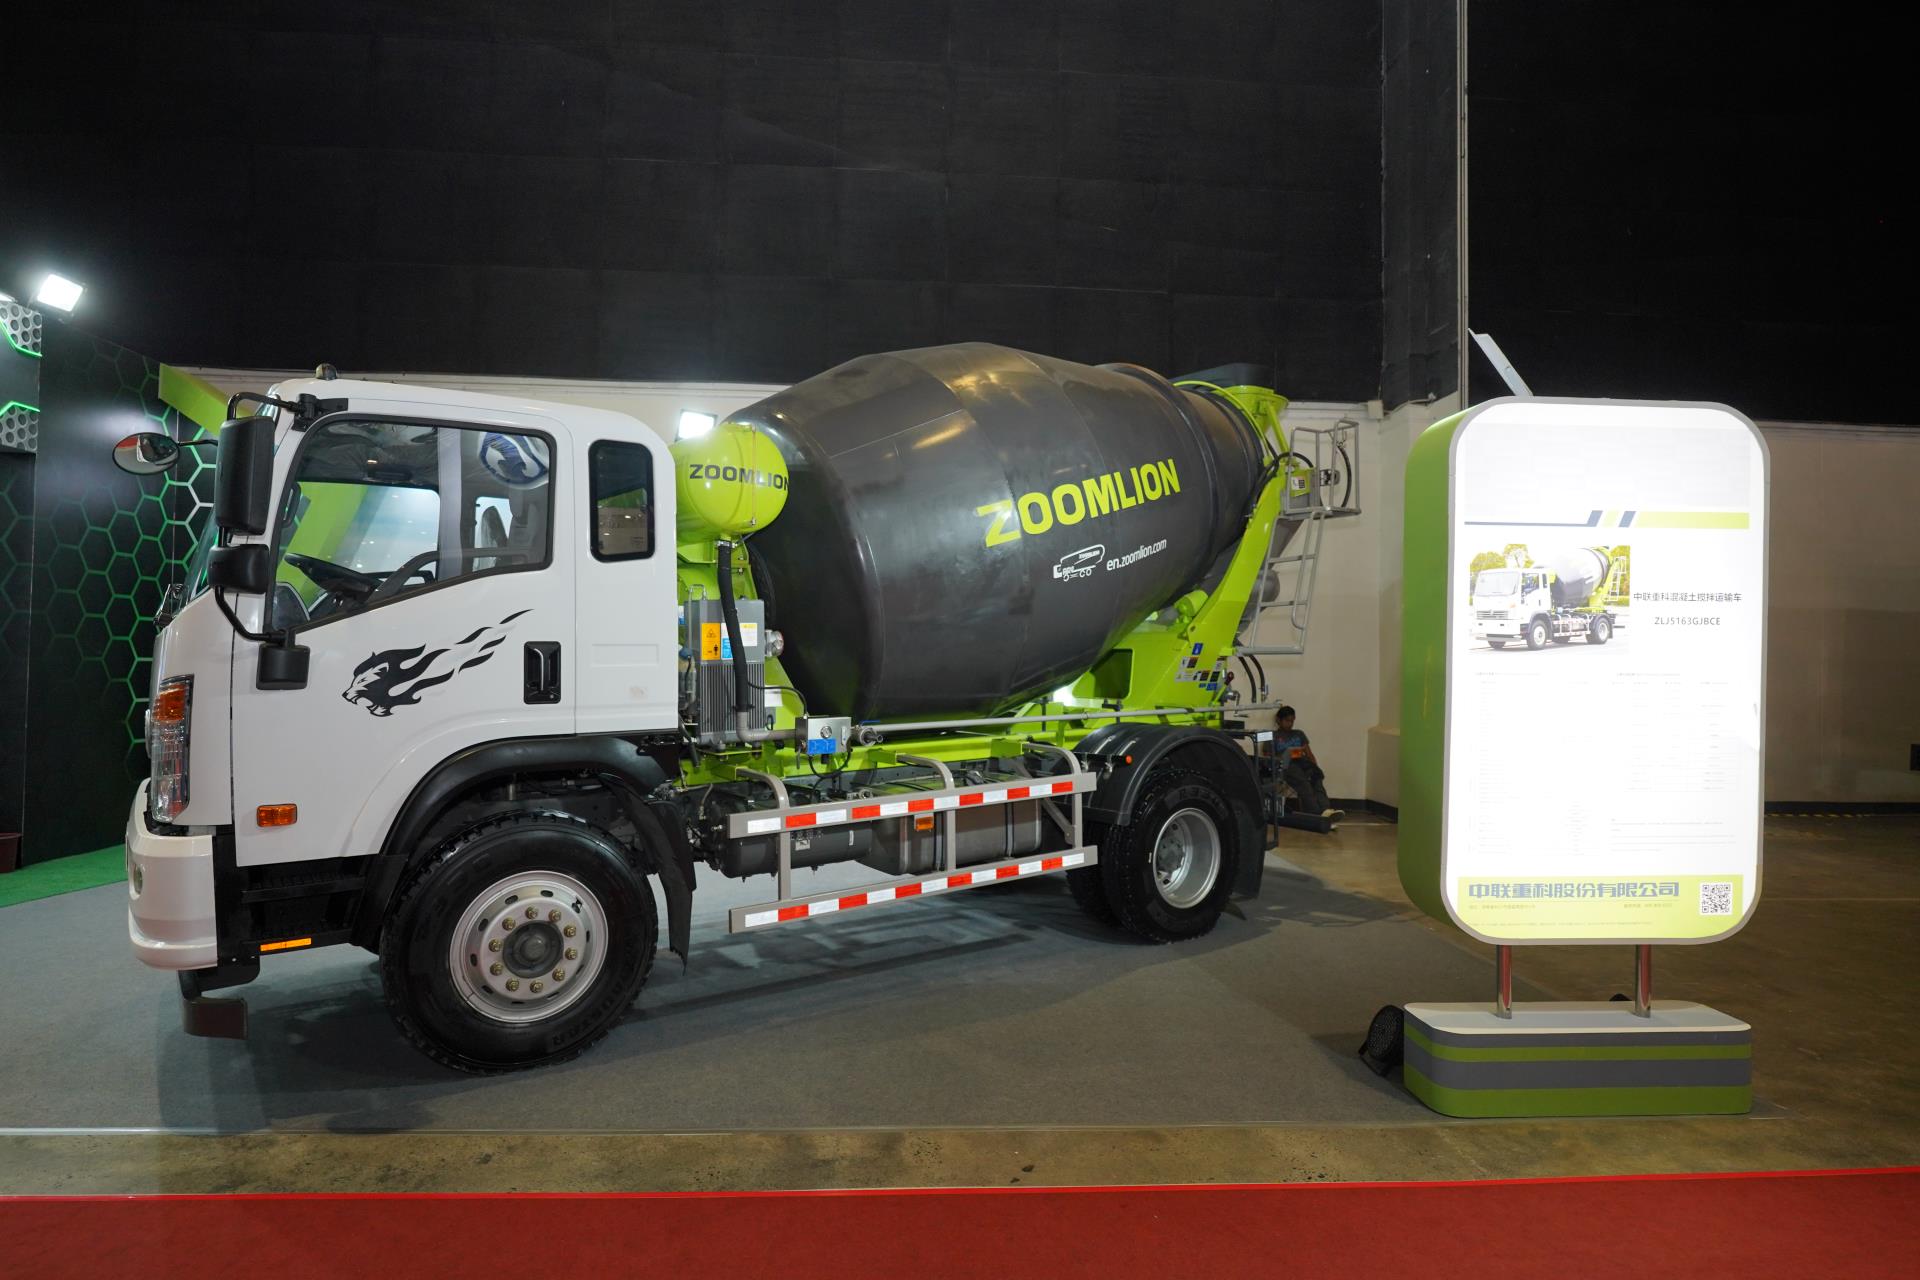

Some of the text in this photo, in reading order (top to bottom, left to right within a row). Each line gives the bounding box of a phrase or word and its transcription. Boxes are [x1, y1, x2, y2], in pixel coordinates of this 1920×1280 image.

[976, 458, 1180, 548] ZOOMLION
[1106, 538, 1167, 571] en.zoomlion.com
[1468, 882, 1680, 899] 中联重科股份有限公司
